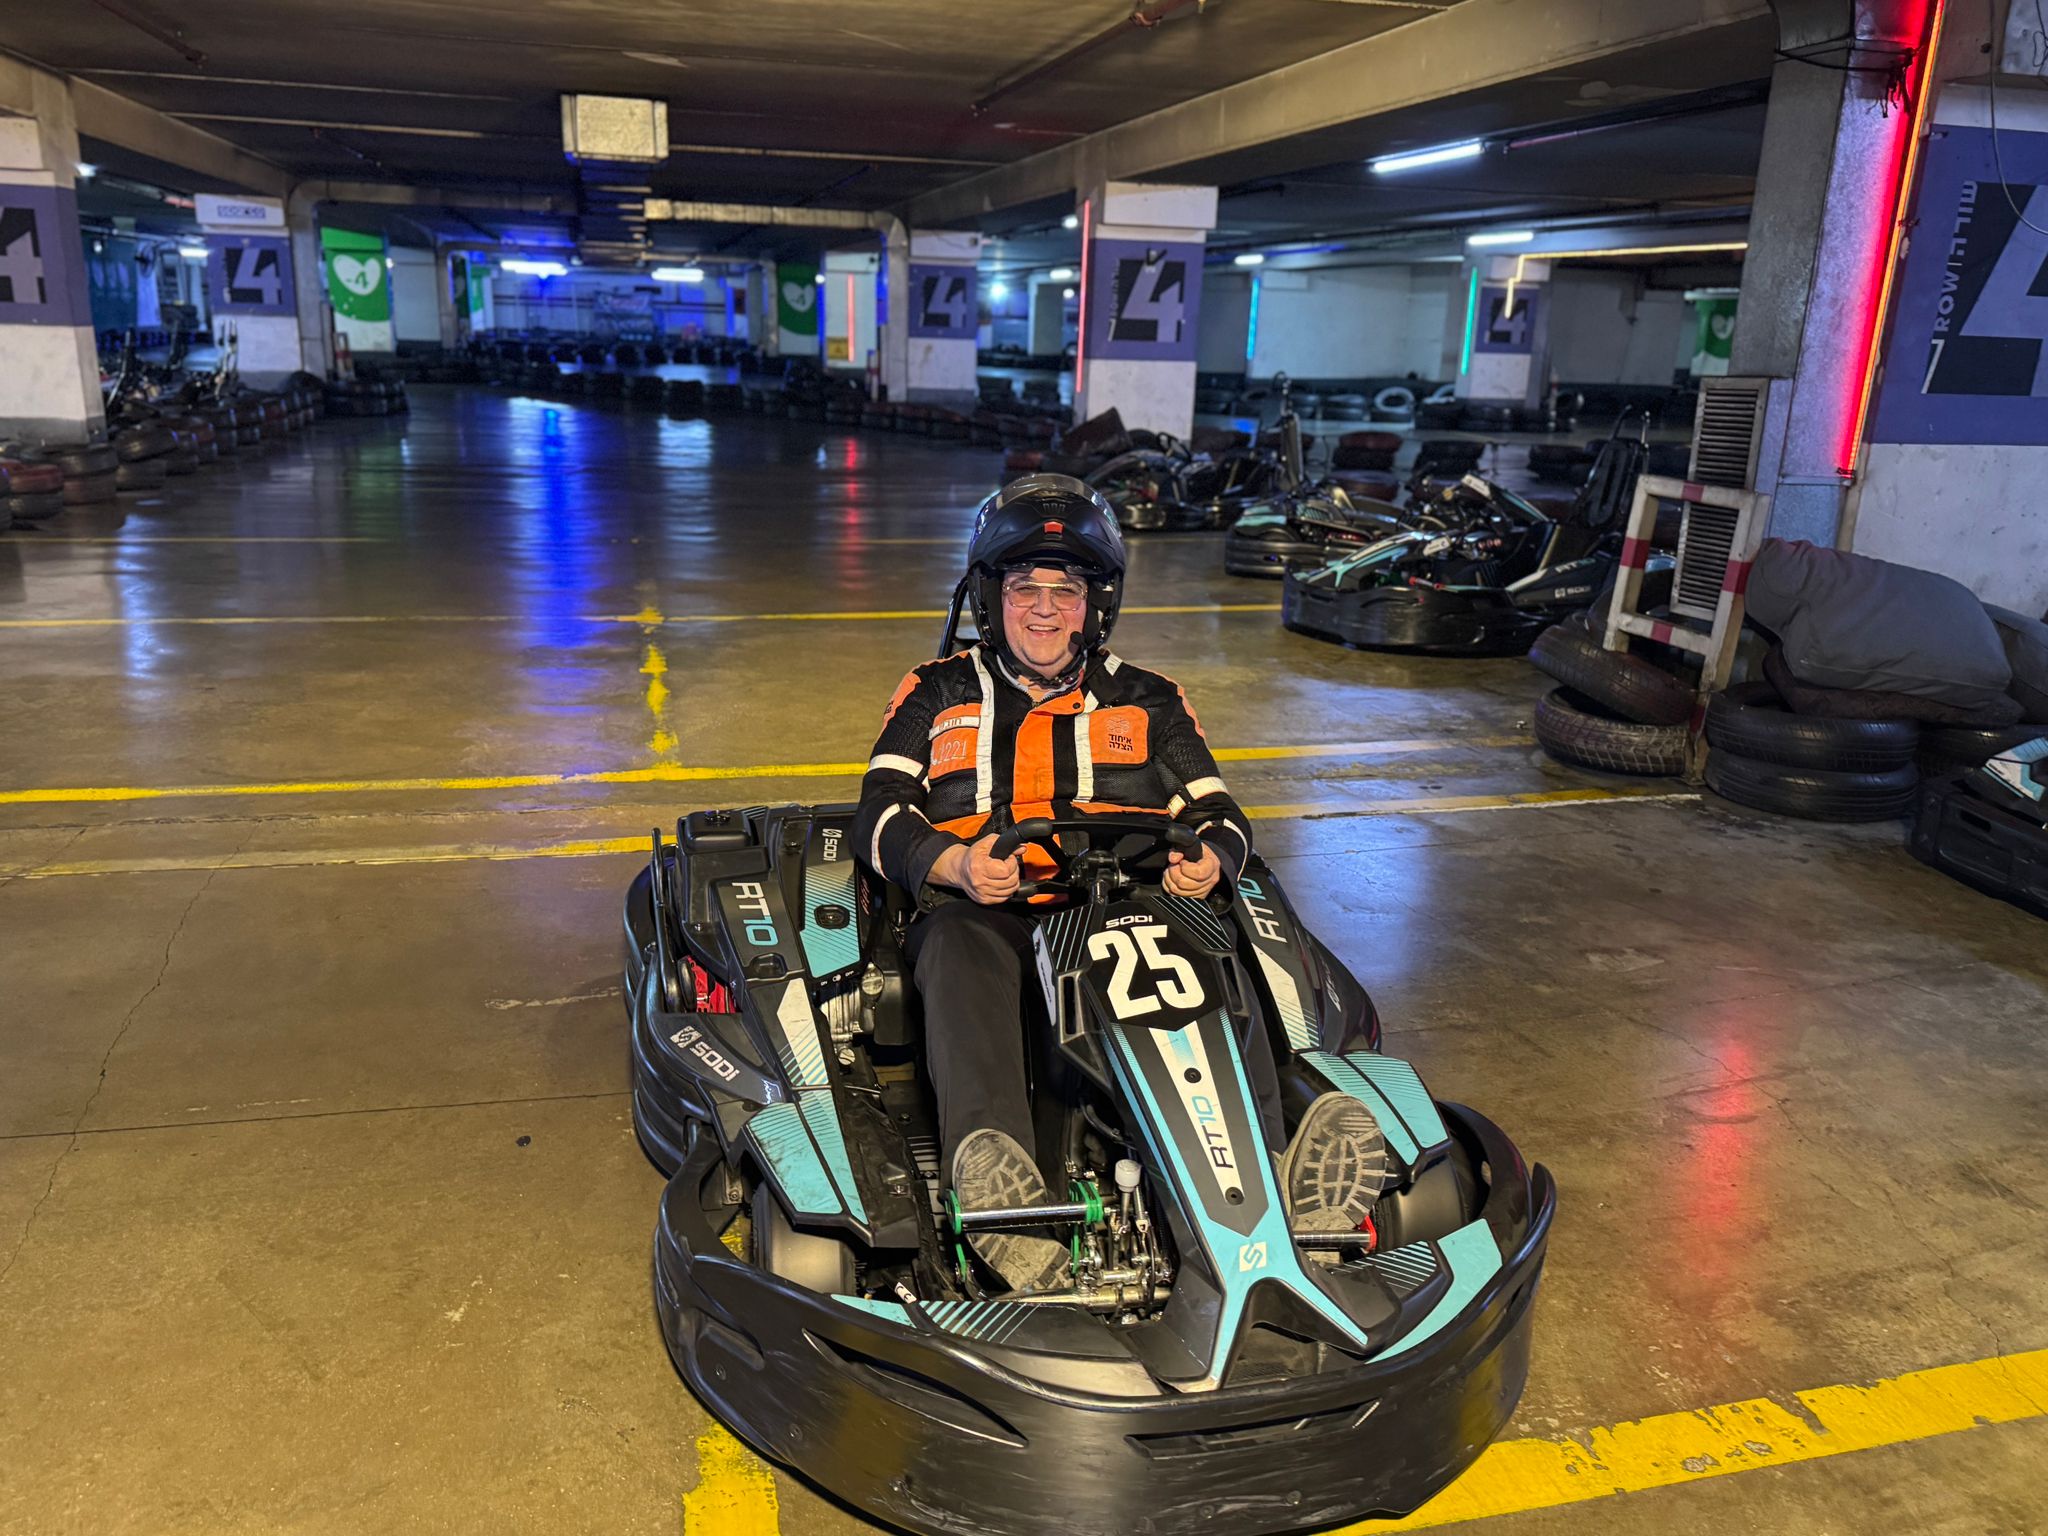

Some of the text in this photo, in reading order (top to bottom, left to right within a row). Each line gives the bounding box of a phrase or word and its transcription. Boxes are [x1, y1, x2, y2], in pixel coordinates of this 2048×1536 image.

[231, 248, 282, 305] 4
[927, 276, 967, 328] 4
[1121, 258, 1184, 342] 4
[1934, 270, 1960, 332] ROW
[1108, 733, 1132, 745] איחוד
[1109, 740, 1133, 752] הצלה
[823, 838, 838, 862] SODI
[731, 882, 779, 947] RT10
[1106, 915, 1153, 929] SODI
[1087, 924, 1206, 1020] 25
[689, 1041, 740, 1082] SODI
[1191, 1095, 1234, 1169] RT10
